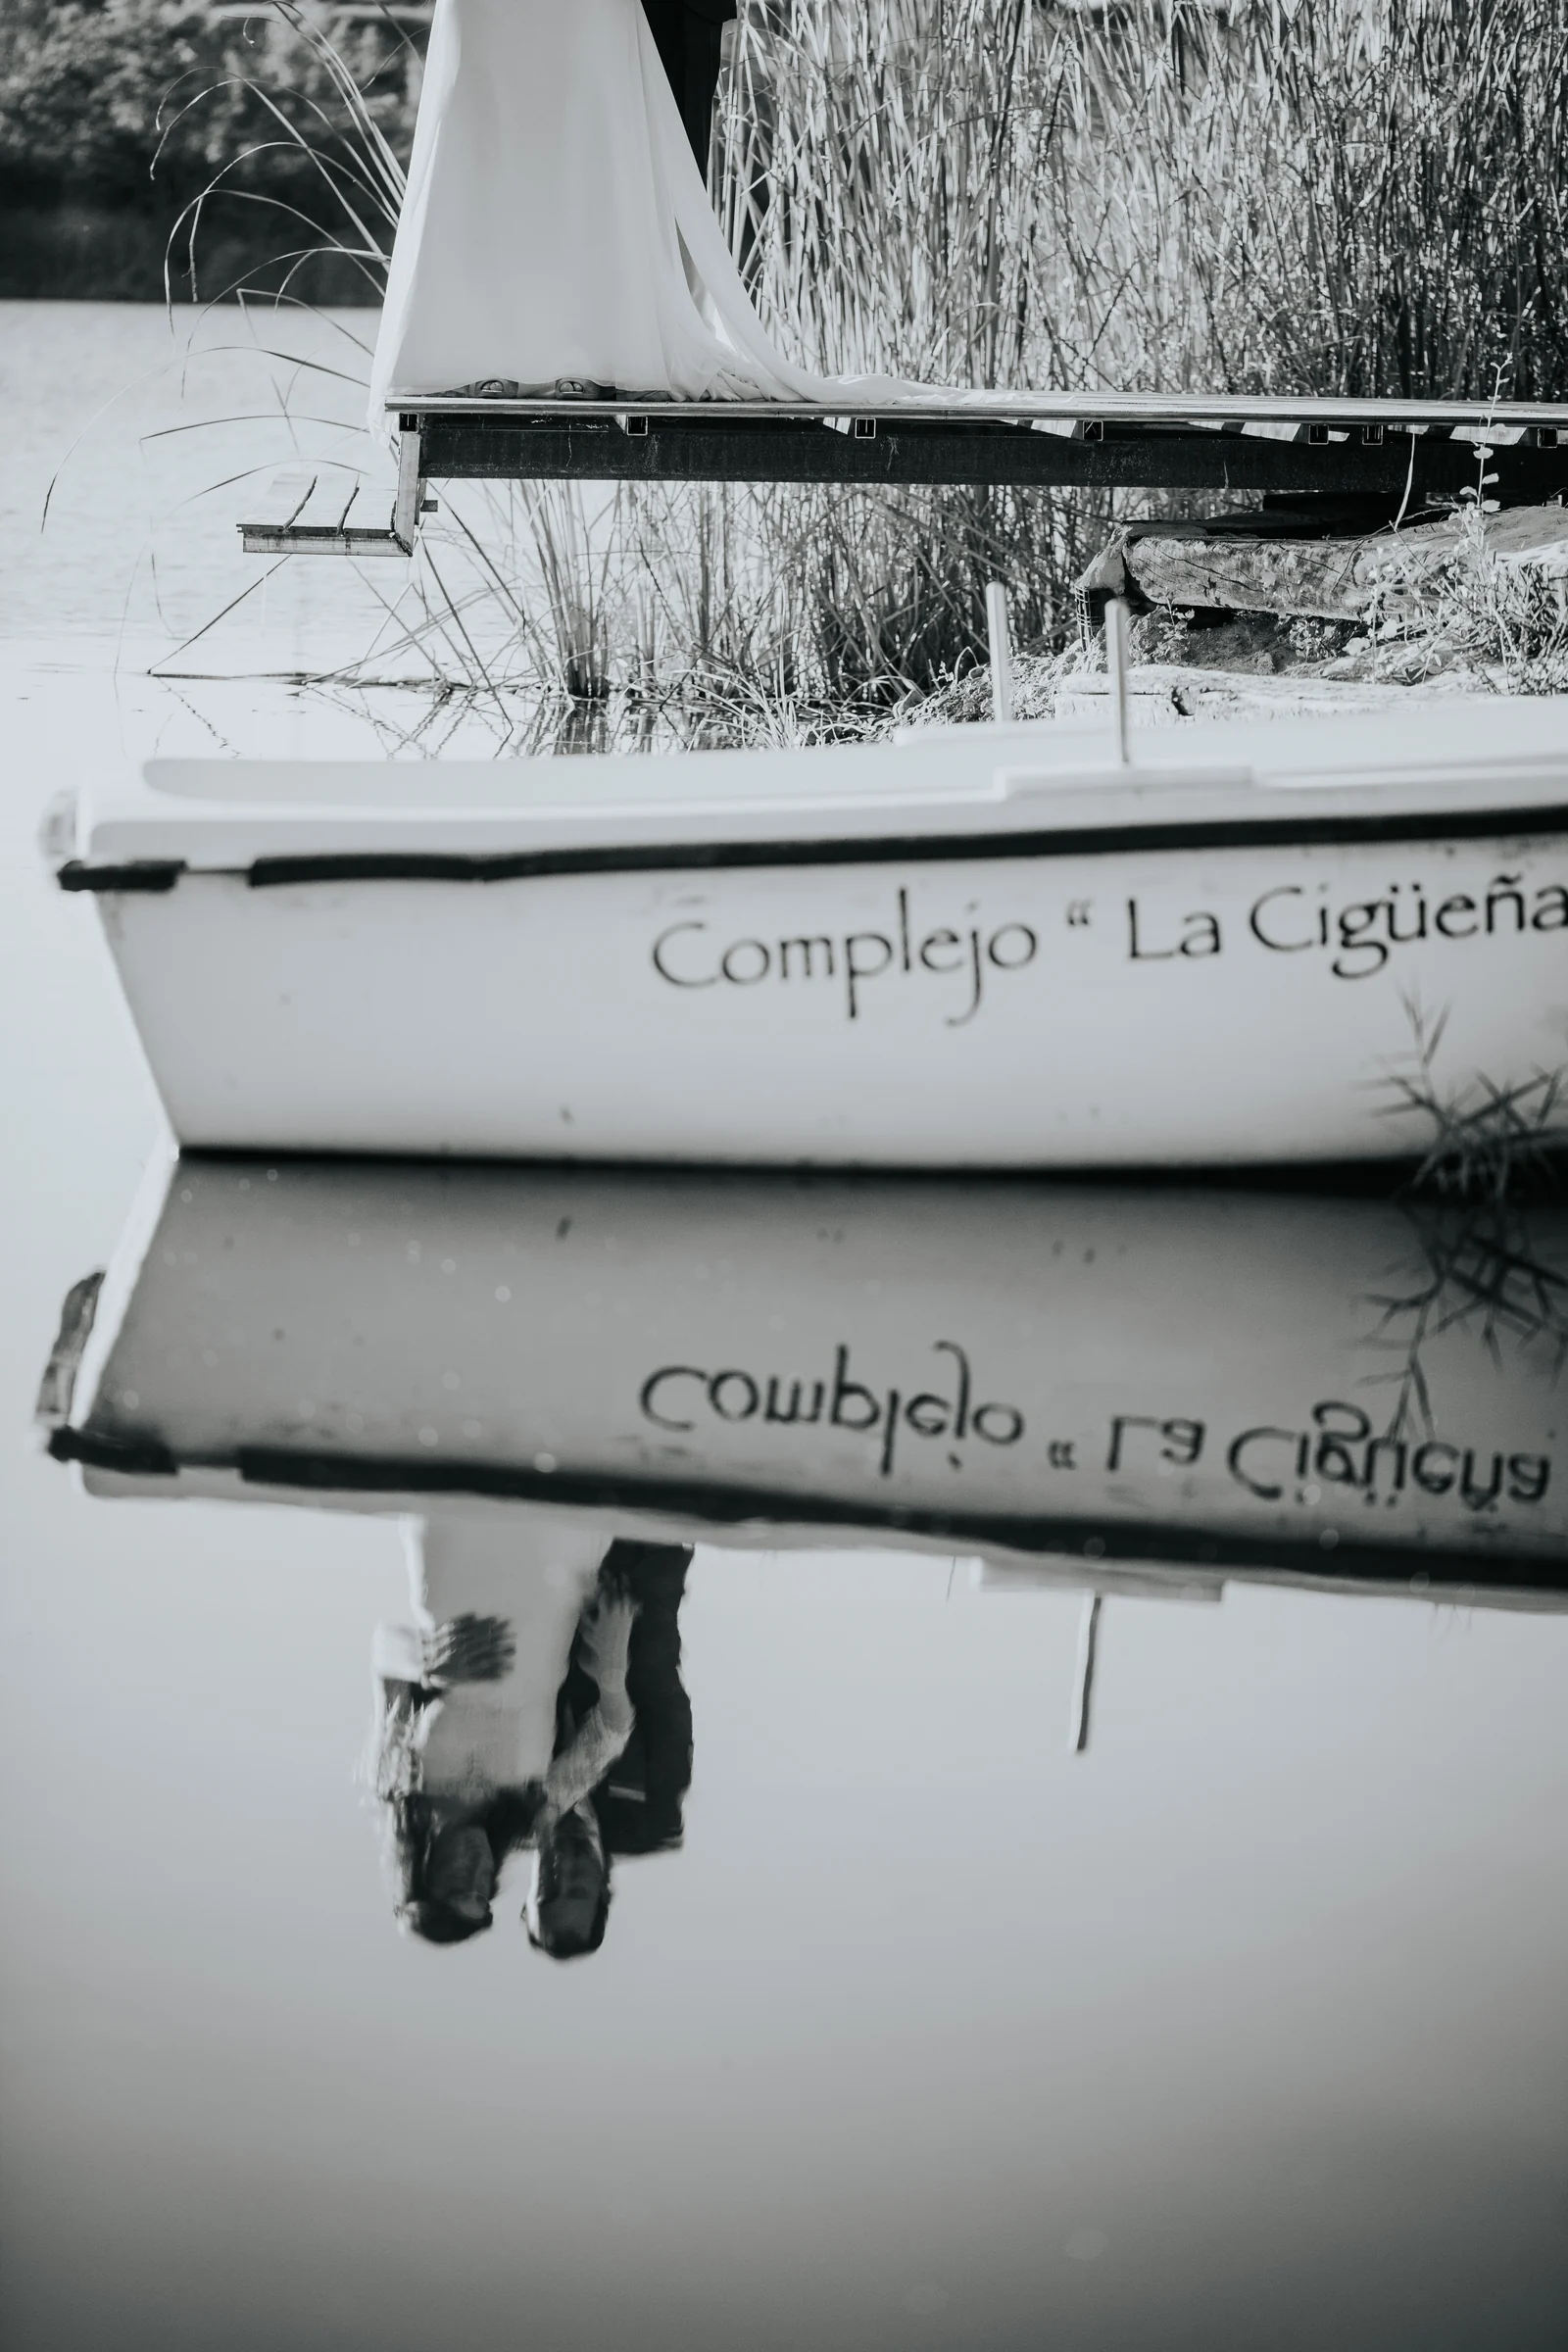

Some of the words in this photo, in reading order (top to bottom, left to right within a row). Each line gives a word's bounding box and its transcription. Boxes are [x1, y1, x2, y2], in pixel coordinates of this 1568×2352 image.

[653, 886, 1037, 1027] Complejo
[1128, 898, 1221, 959] La
[1250, 874, 1568, 979] Cigüeña
